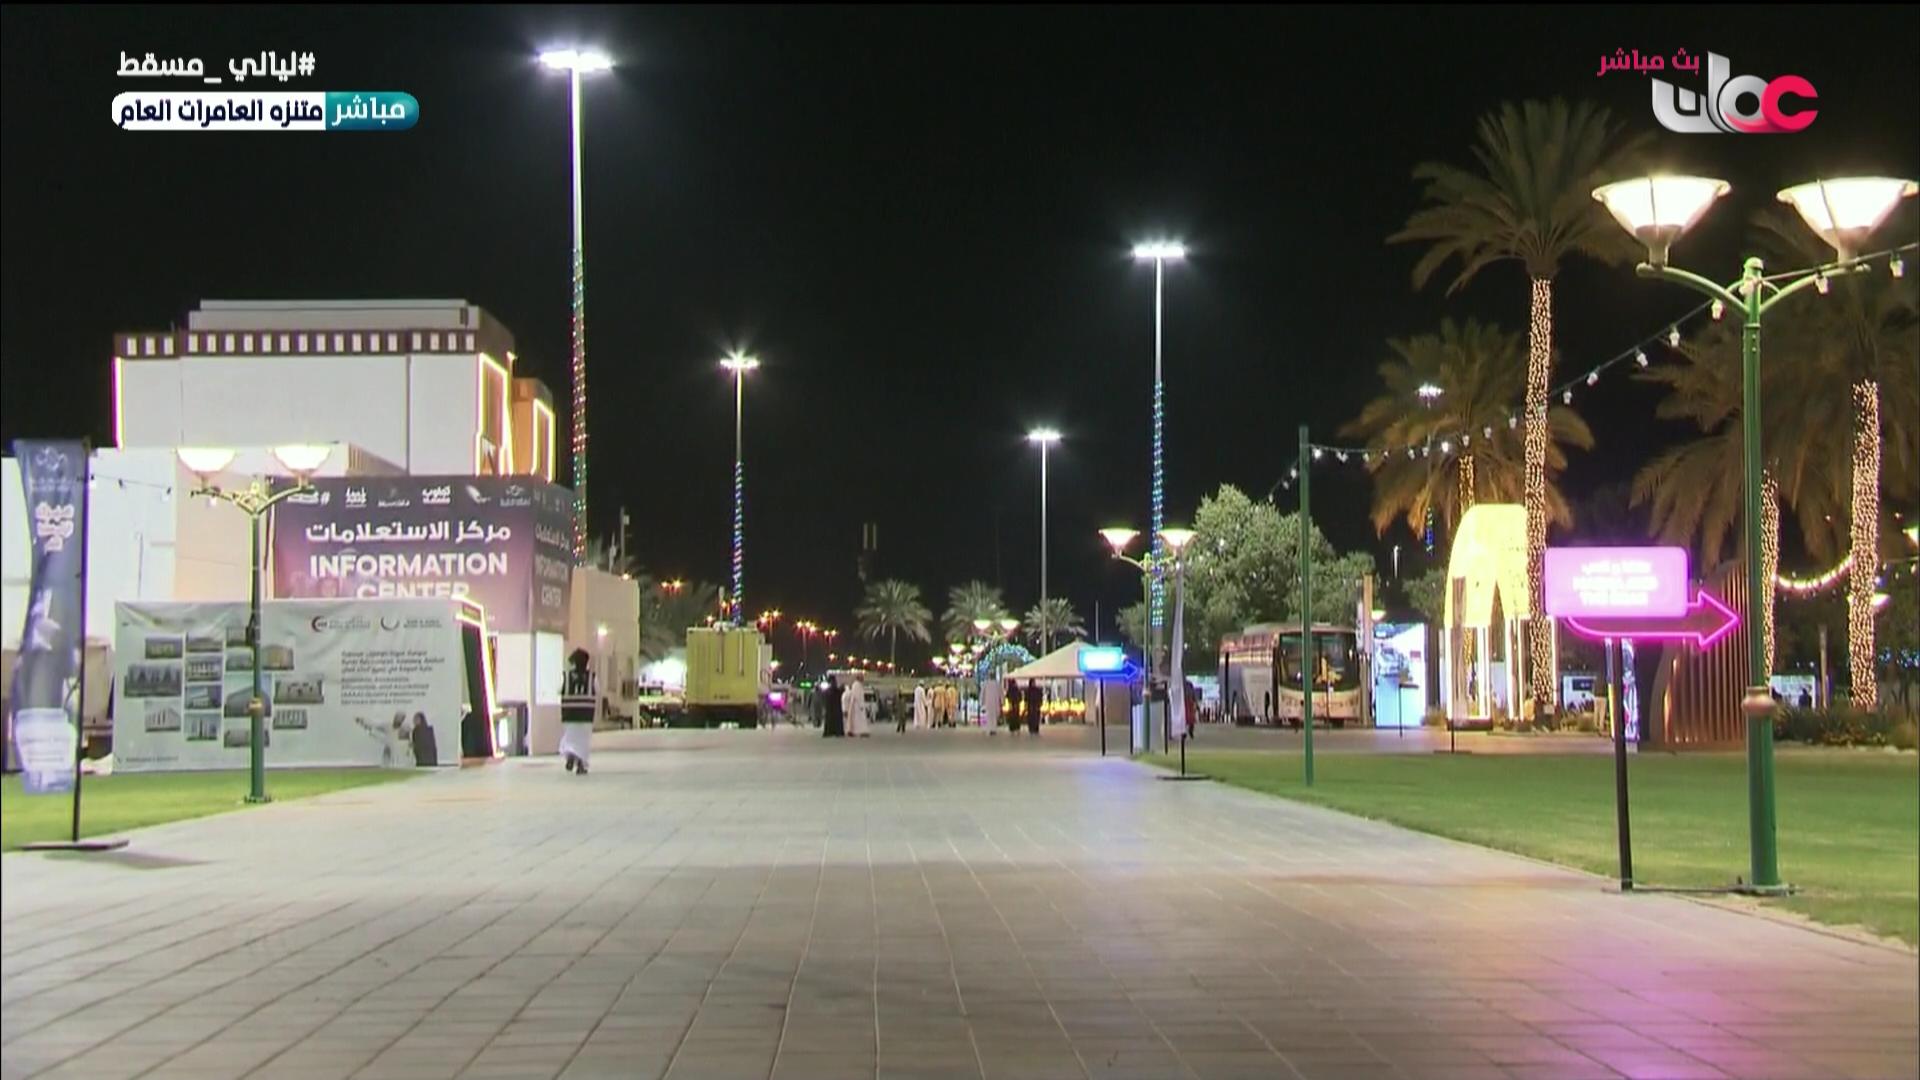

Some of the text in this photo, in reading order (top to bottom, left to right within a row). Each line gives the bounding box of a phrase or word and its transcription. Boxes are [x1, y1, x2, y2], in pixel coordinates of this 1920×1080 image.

[306, 520, 450, 544] الاستعلامات
[456, 522, 511, 544] مركز
[310, 552, 507, 577] INFORMATION
